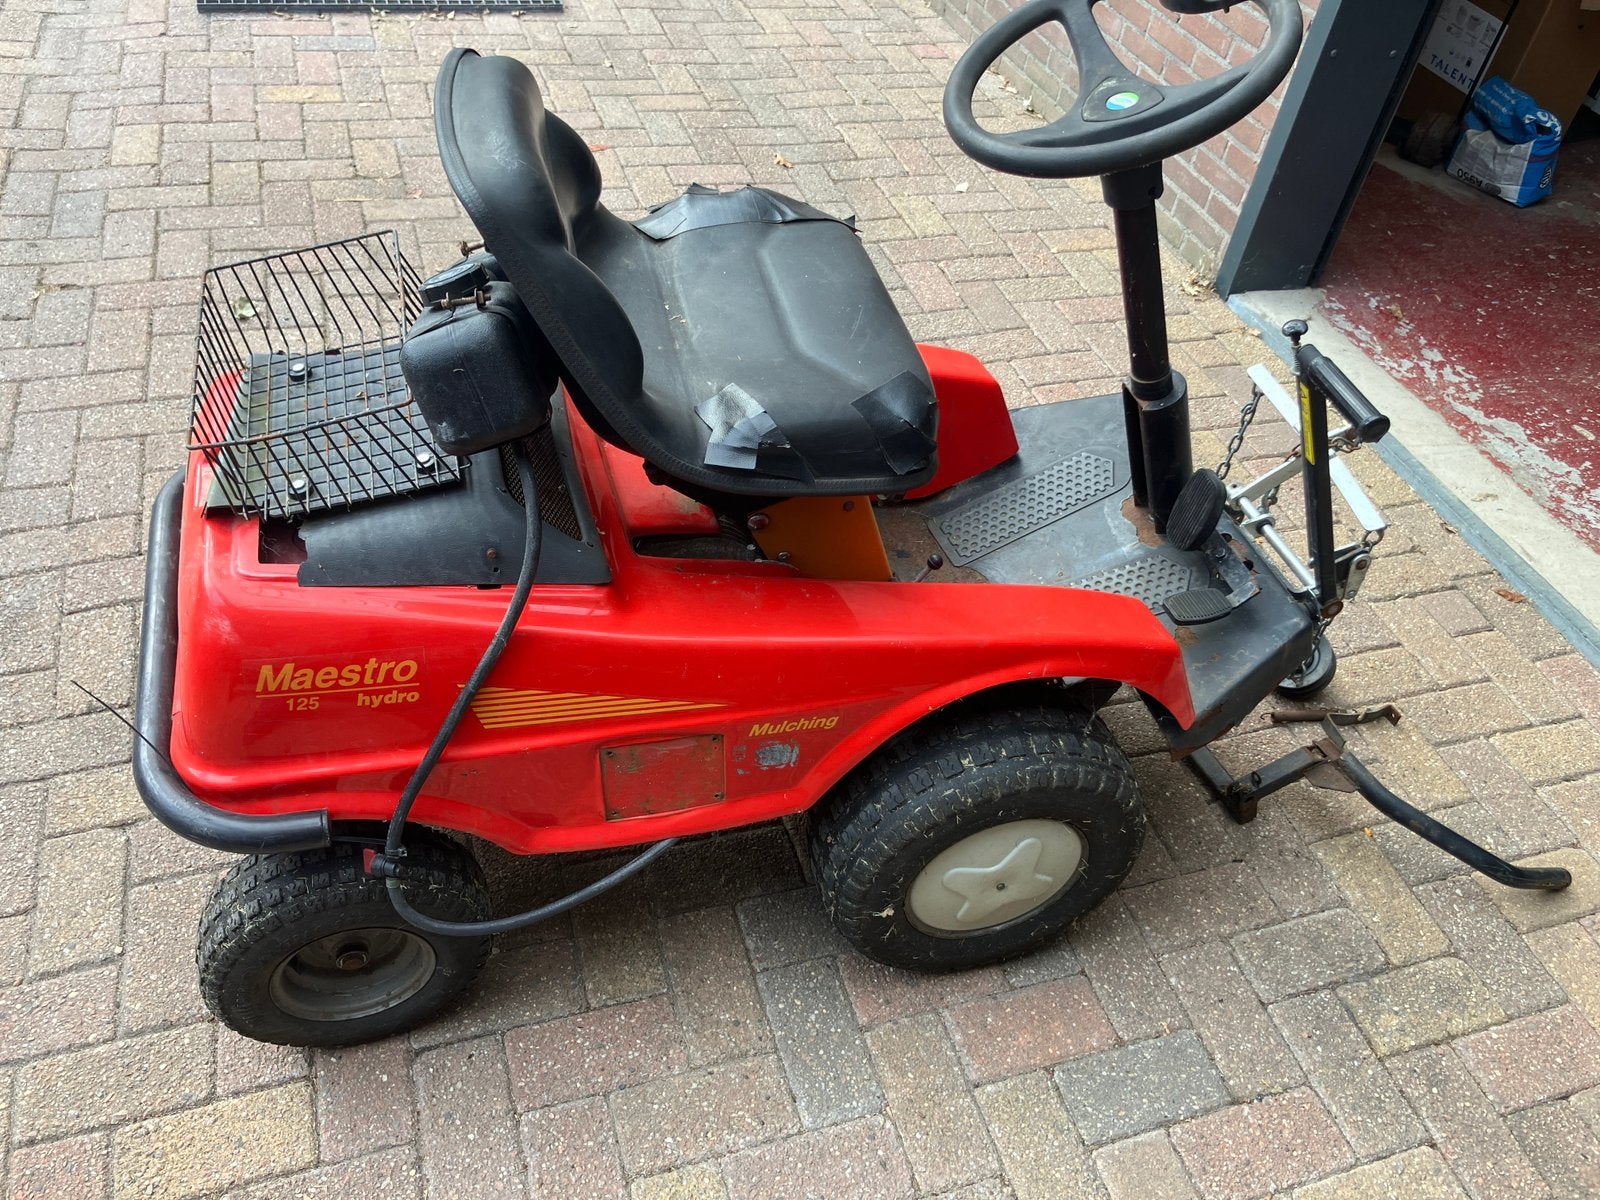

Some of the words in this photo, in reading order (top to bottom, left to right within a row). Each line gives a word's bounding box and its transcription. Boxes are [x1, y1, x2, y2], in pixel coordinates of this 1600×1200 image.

[1430, 54, 1475, 89] TALENT
[255, 657, 418, 692] Maestro
[286, 696, 320, 711] 125
[356, 690, 420, 708] hydro
[749, 716, 839, 737] Mulching
